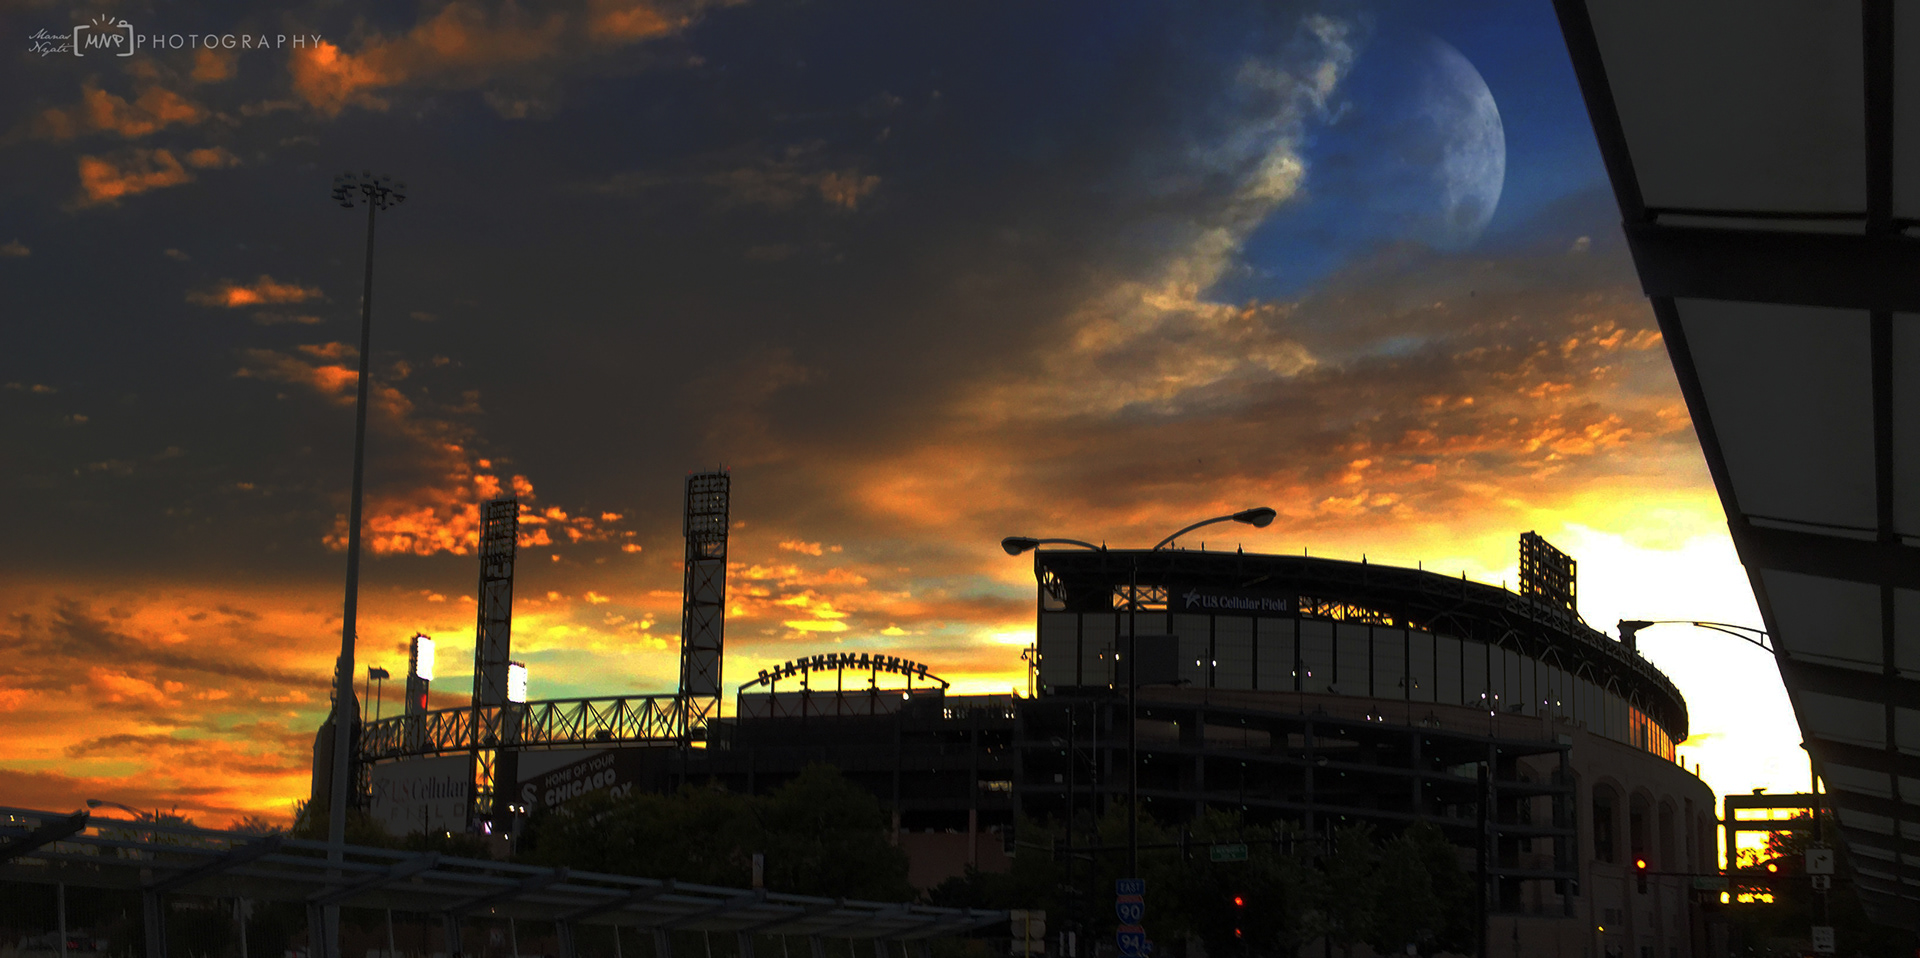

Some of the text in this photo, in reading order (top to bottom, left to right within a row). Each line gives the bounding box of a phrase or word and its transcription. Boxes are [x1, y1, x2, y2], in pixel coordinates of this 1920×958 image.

[1219, 596, 1260, 610] Cellular
[1261, 597, 1287, 611] Field
[545, 754, 616, 788] HOME OF YOUR
[412, 774, 467, 800] Cellular
[544, 768, 617, 807] CHICAGO
[391, 803, 465, 820] FIELD
[1119, 882, 1140, 894] EAST
[1120, 904, 1140, 920] 90
[1121, 934, 1139, 951] 94
